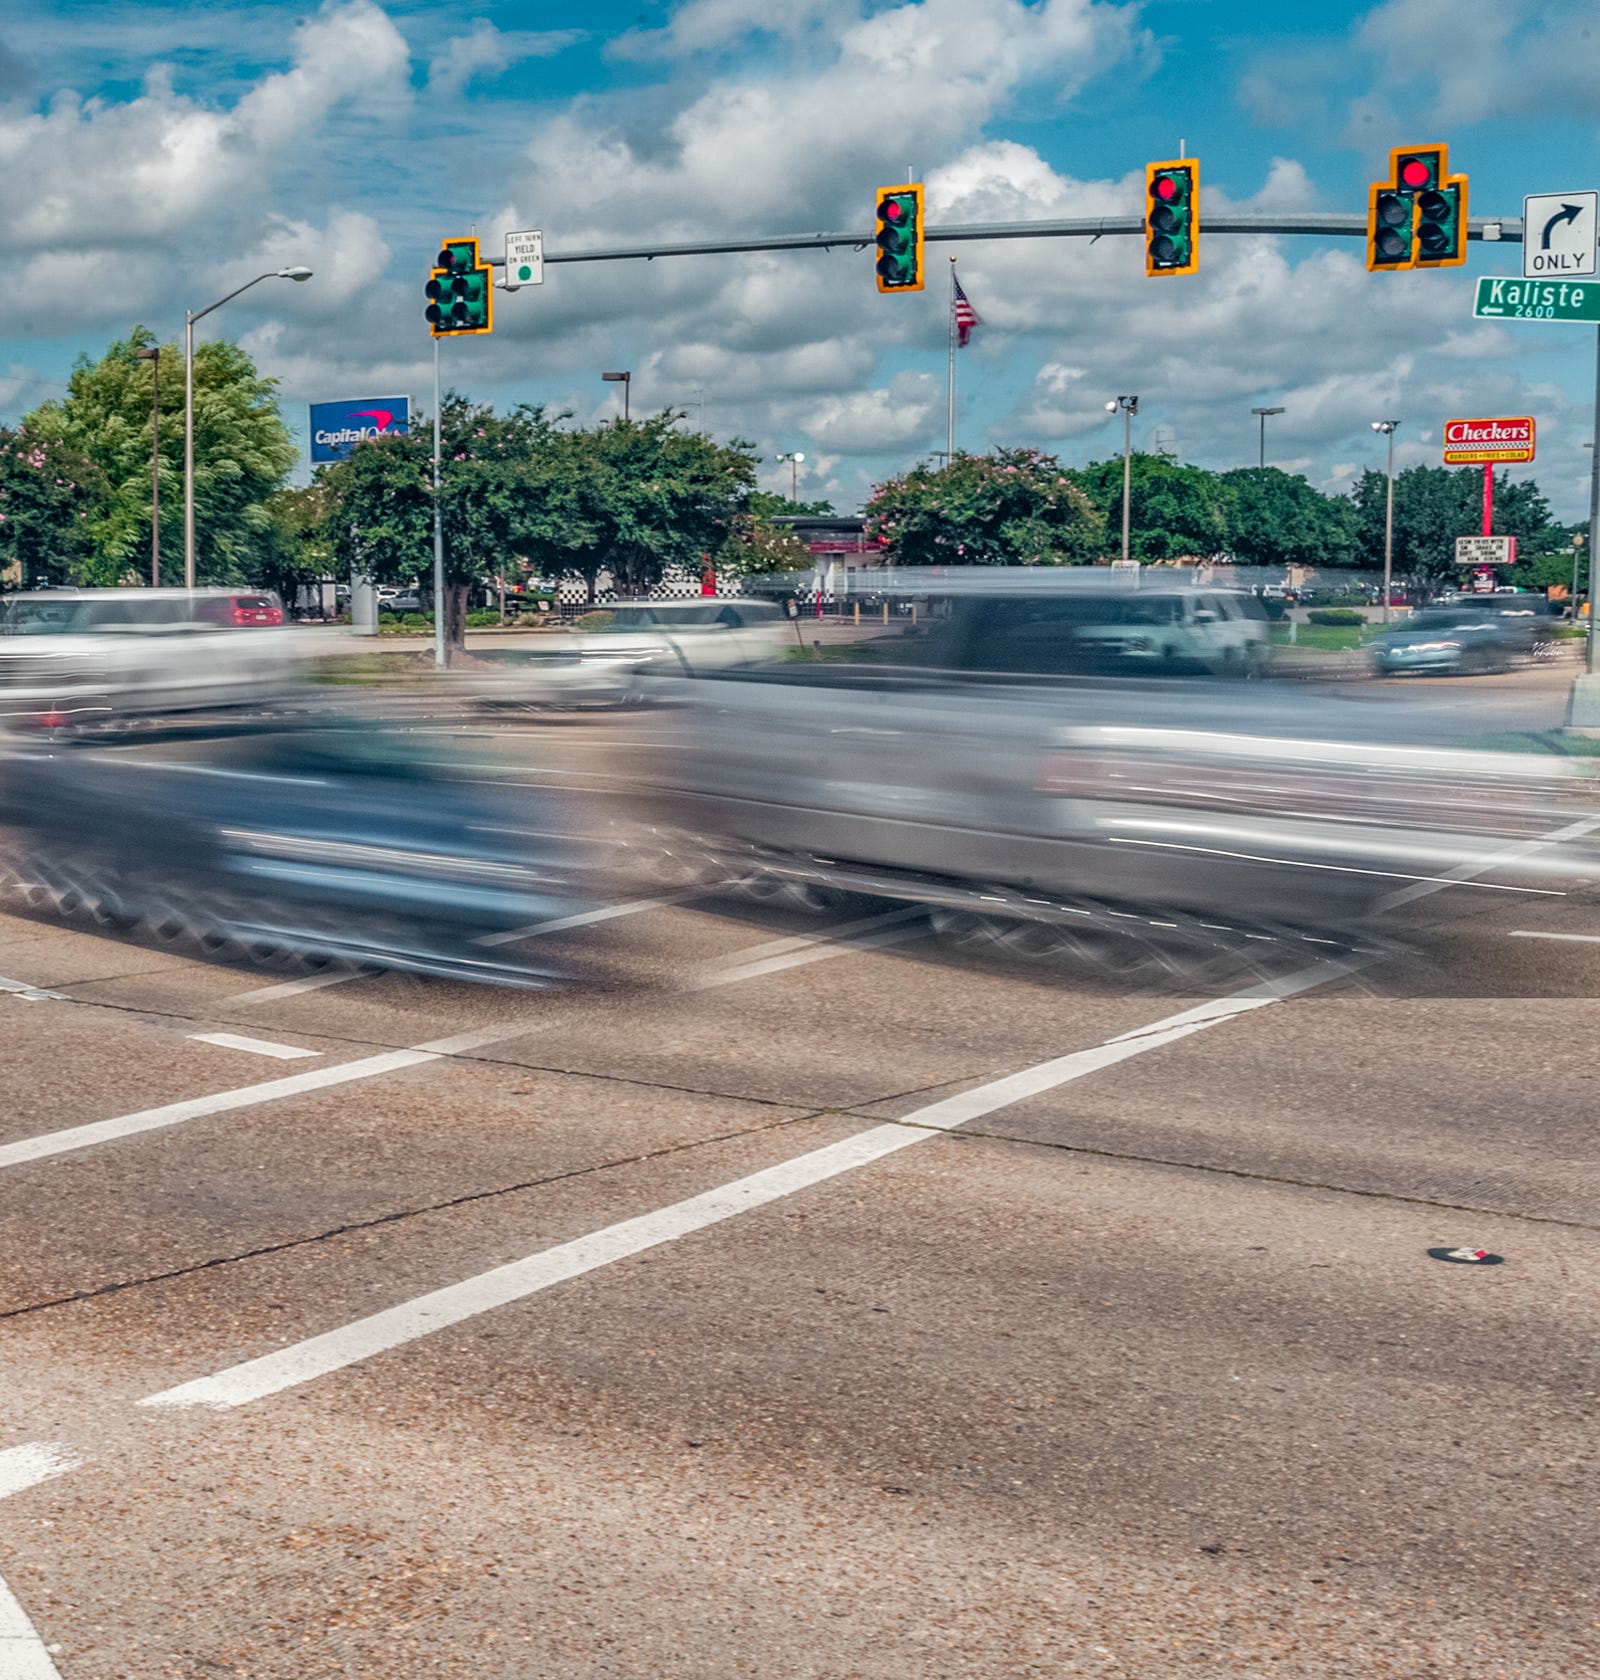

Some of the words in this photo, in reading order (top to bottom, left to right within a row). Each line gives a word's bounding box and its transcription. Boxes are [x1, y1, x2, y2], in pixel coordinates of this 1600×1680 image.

[514, 244, 535, 254] YIELD
[1533, 252, 1585, 271] ONLY
[1490, 279, 1585, 308] Kaliste
[1514, 305, 1555, 318] 2600
[1447, 421, 1529, 442] Checkers
